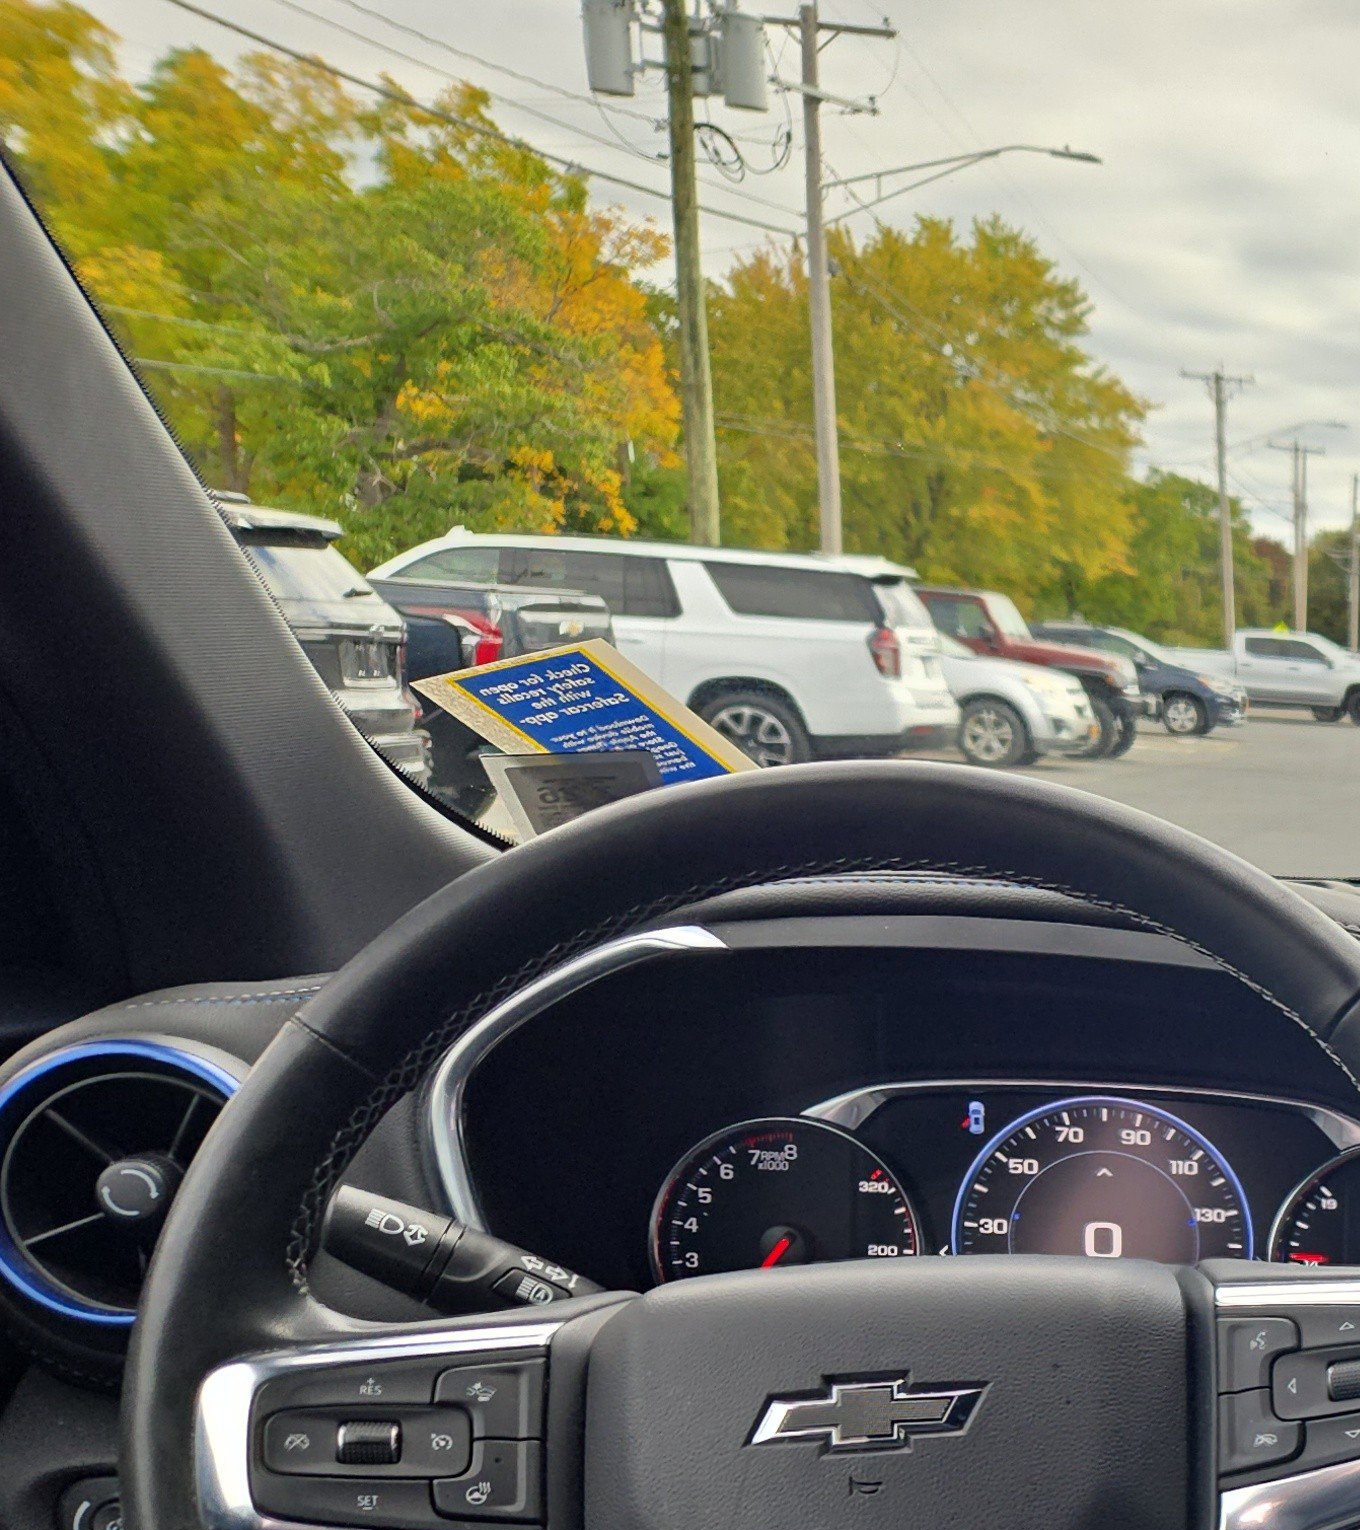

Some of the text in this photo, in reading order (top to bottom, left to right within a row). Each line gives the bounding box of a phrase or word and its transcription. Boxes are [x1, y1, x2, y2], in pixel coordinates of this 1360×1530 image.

[1055, 1126, 1084, 1143] 70
[1121, 1129, 1151, 1146] 90
[748, 1149, 760, 1165] 7
[784, 1144, 798, 1160] 8
[719, 1163, 734, 1180] 6
[1008, 1158, 1039, 1175] 50
[1169, 1160, 1198, 1175] 110
[858, 1181, 888, 1193] 320
[698, 1187, 712, 1204] 5
[1194, 1207, 1226, 1223] 130
[684, 1217, 699, 1233] 4
[978, 1218, 1008, 1235] 30
[1084, 1222, 1122, 1258] 0
[867, 1244, 898, 1257] 200
[685, 1251, 699, 1268] 3
[359, 1384, 382, 1395] RES
[357, 1495, 378, 1507] SET
